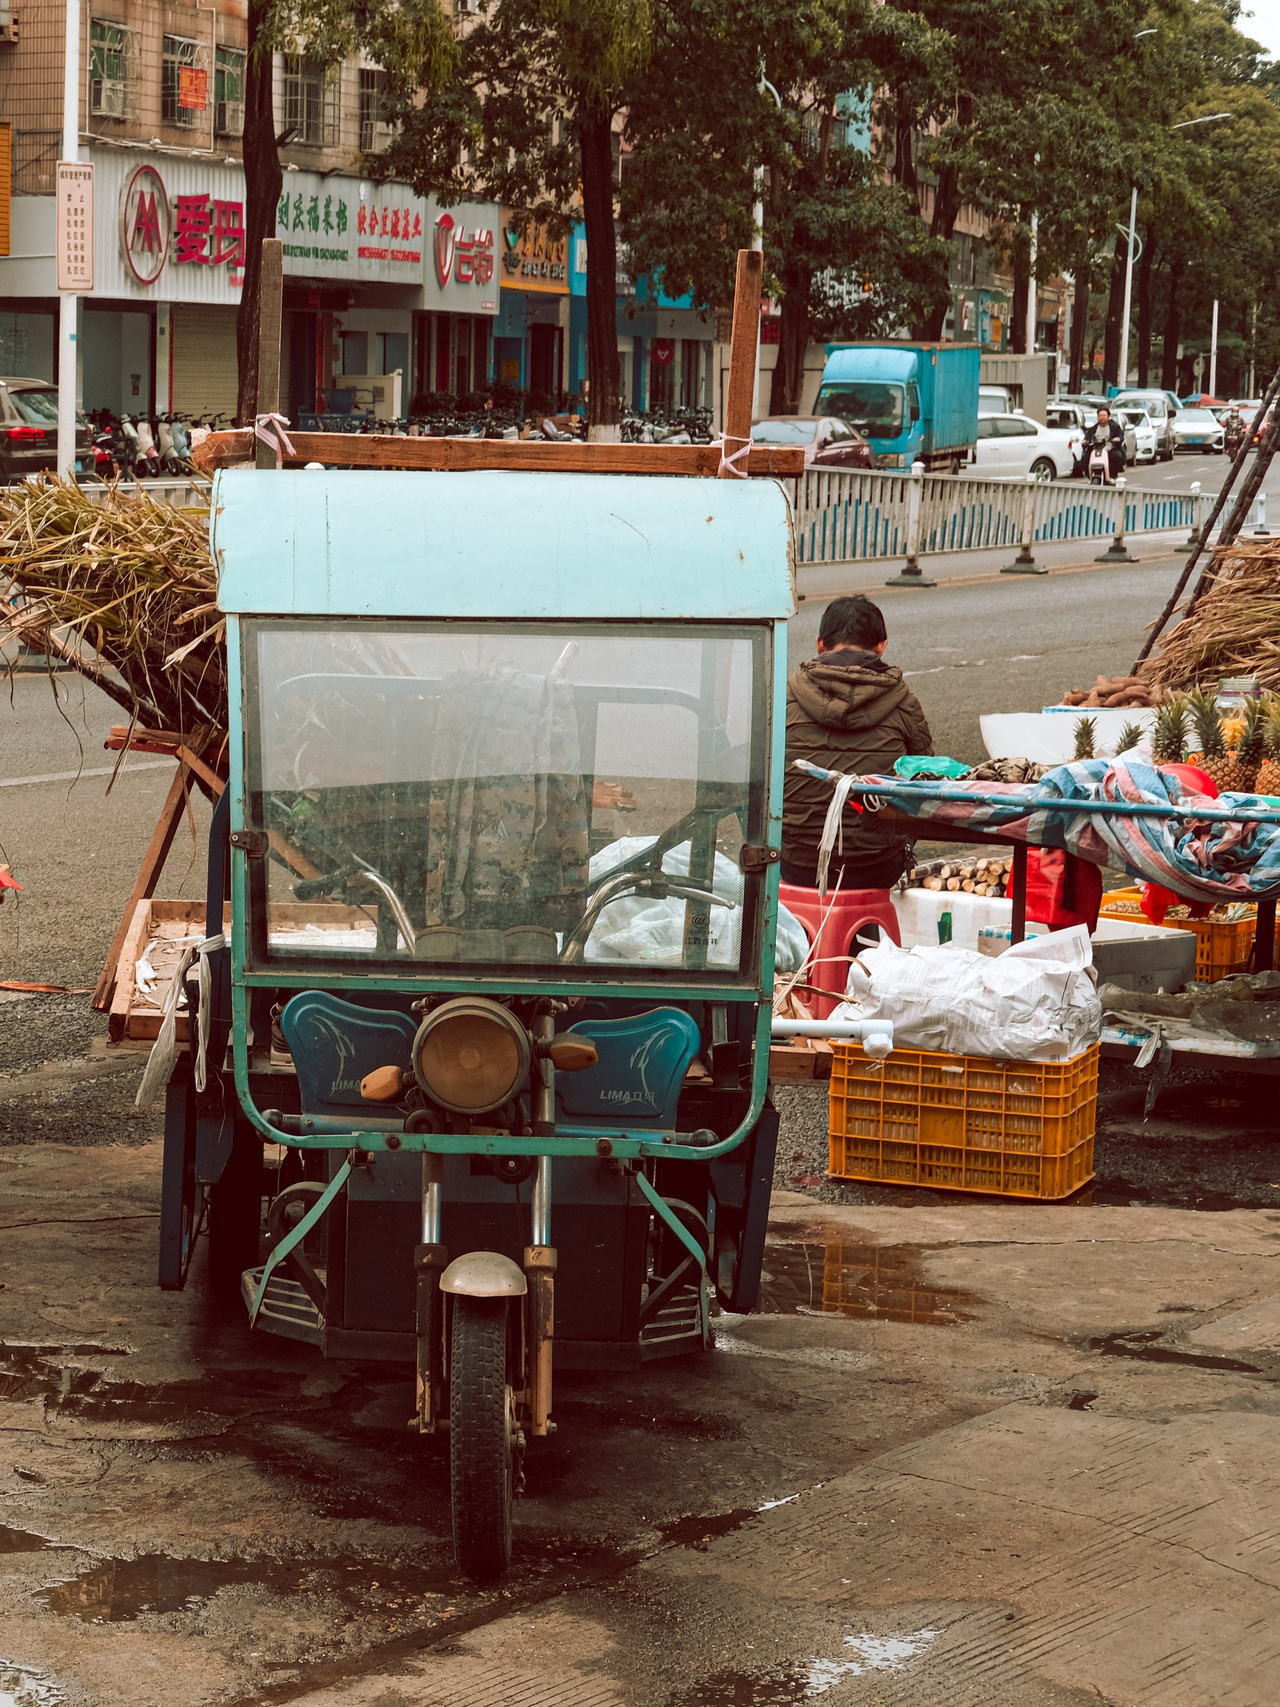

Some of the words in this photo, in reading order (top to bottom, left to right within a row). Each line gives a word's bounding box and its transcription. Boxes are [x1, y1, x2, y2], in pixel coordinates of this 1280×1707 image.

[172, 193, 245, 267] 爱玛
[455, 226, 494, 285] 台铃
[599, 1090, 631, 1101] LIMA
